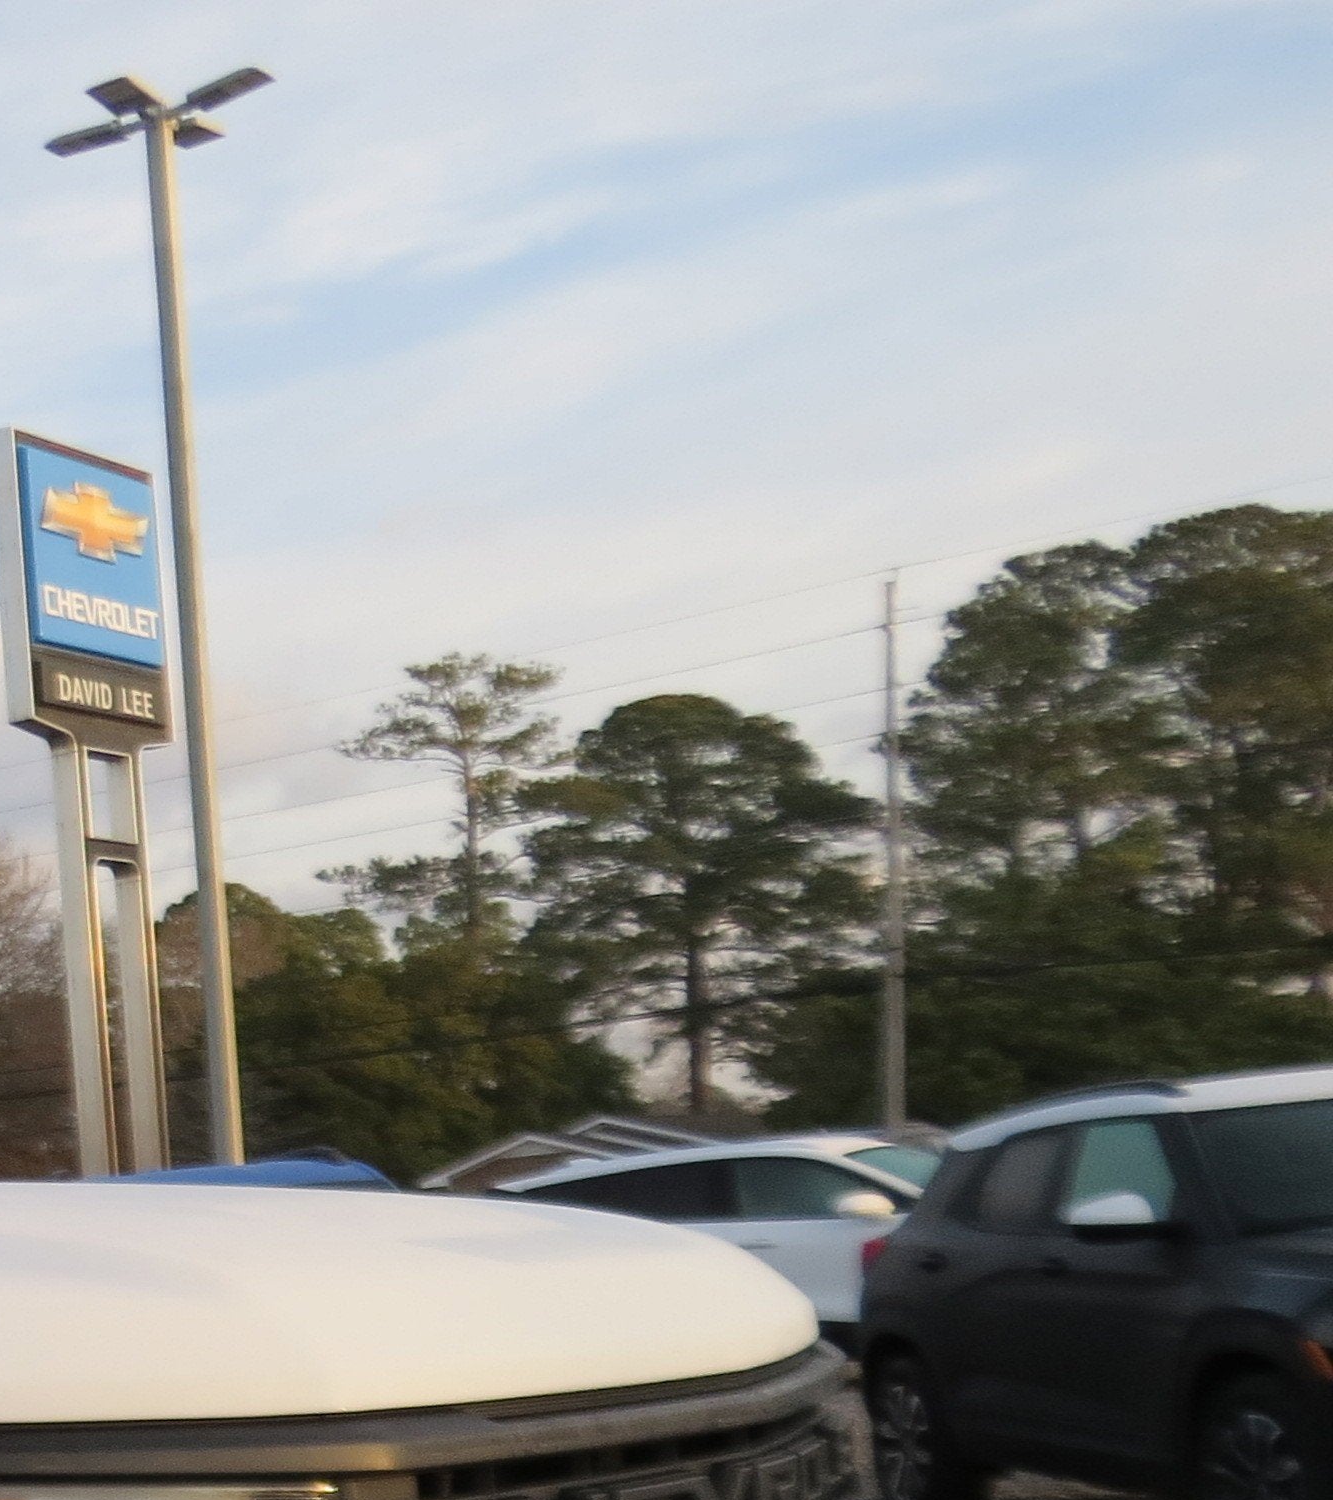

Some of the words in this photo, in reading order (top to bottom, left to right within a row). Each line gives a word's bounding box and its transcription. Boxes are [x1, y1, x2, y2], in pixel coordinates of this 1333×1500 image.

[41, 583, 159, 640] CHEVROLET
[57, 673, 113, 710] DAVID
[121, 686, 156, 720] LEE
